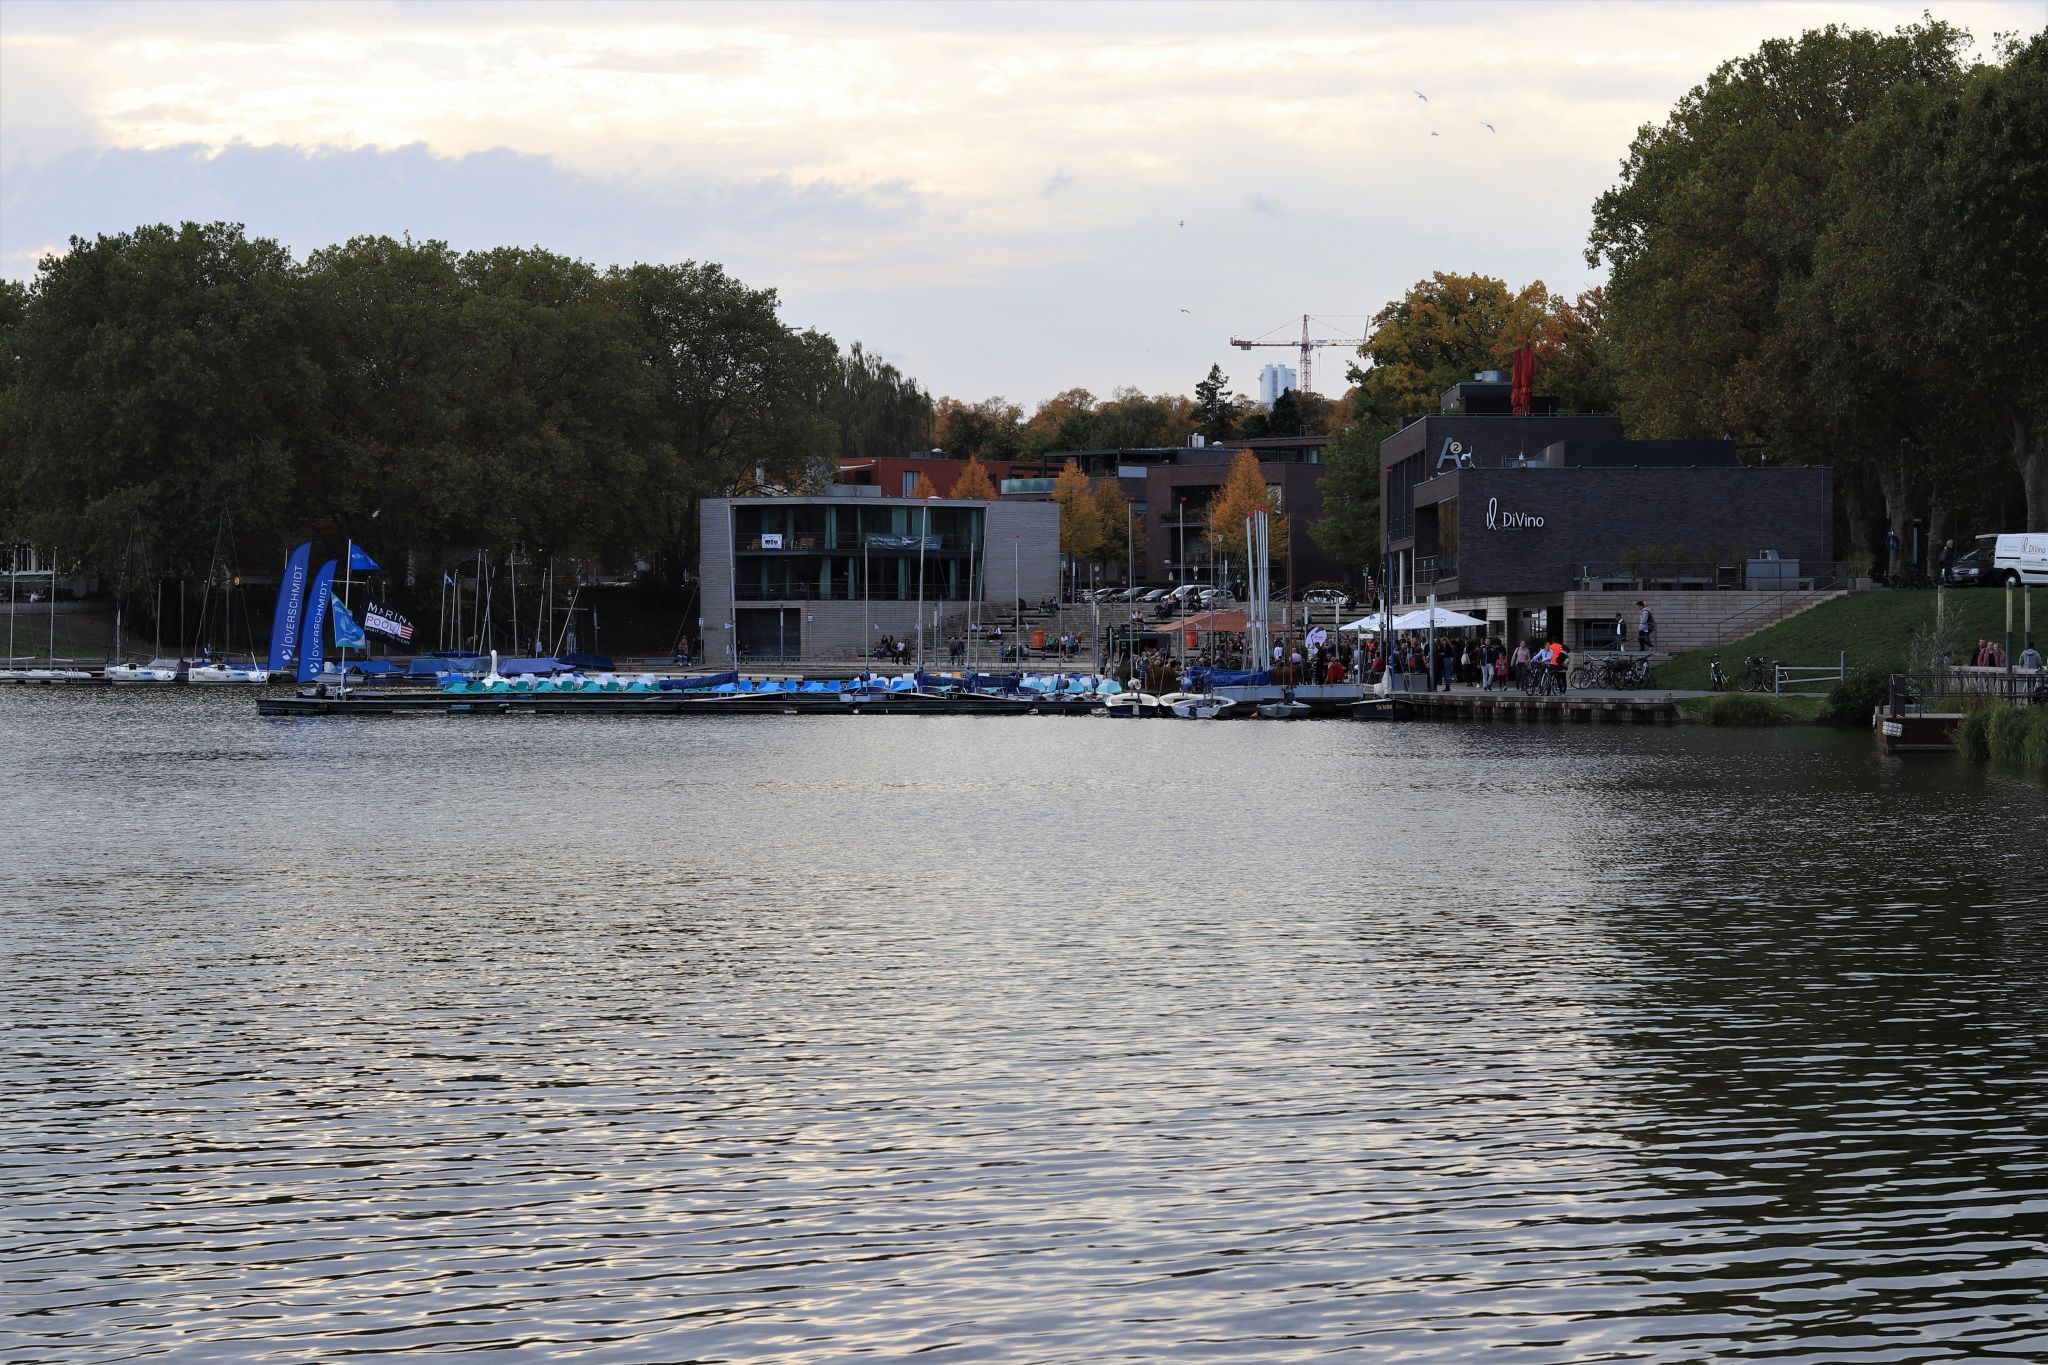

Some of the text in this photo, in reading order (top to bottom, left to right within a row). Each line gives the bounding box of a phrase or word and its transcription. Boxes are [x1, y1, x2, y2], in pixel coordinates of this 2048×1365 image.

[1503, 512, 1545, 528] DiVino
[2028, 544, 2046, 554] DiVino
[284, 565, 303, 644] OVERSCHMIDT
[311, 580, 329, 657] OVERSCHMIDT
